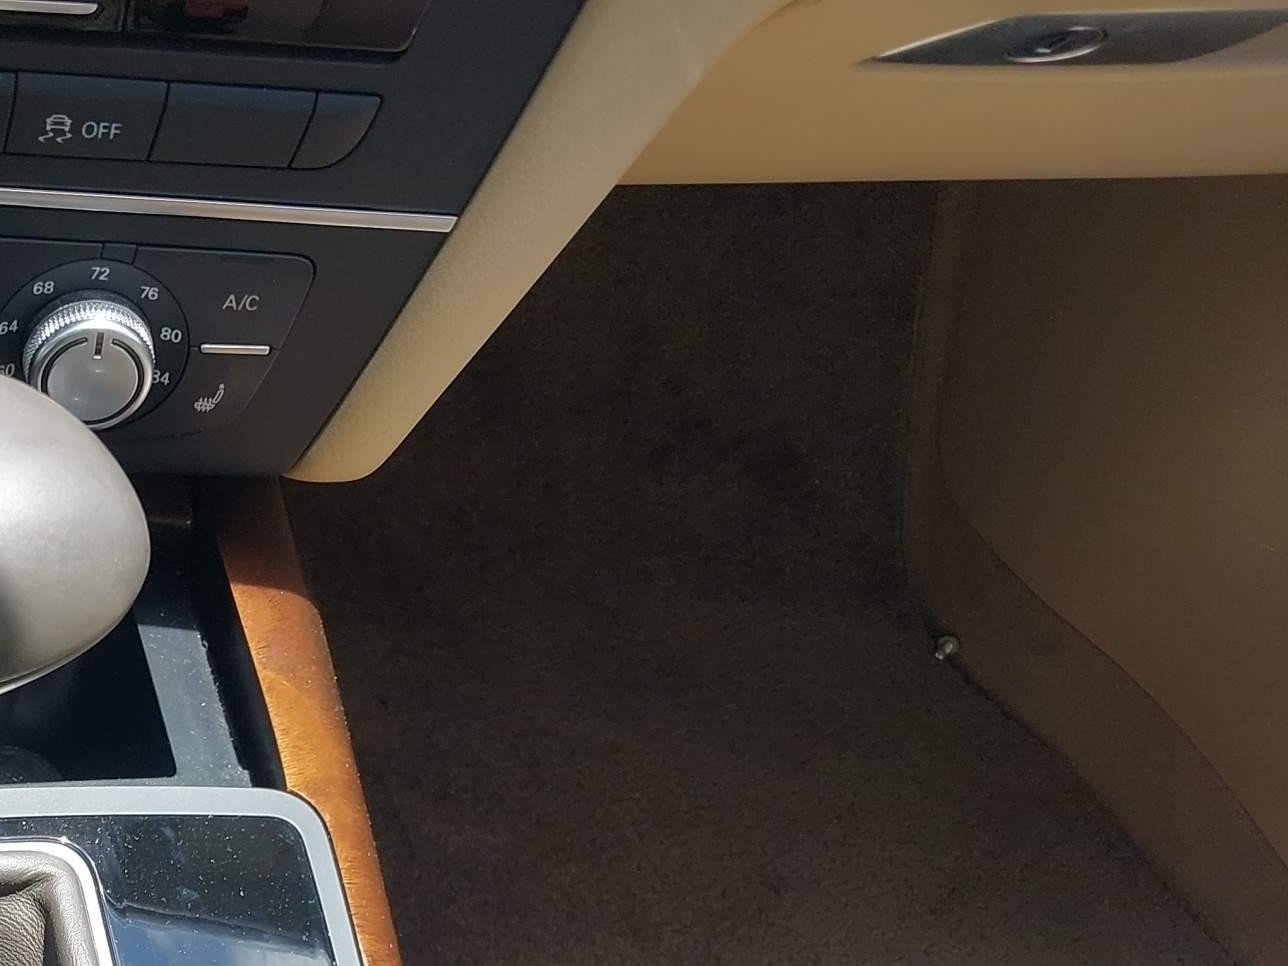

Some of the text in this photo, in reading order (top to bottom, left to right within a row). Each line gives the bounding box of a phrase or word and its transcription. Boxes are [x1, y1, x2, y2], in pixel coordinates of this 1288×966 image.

[81, 121, 123, 140] OFF
[90, 266, 111, 281] 72
[32, 281, 55, 295] 68
[139, 285, 160, 301] 76
[222, 294, 260, 312] A/C
[160, 327, 183, 343] 80
